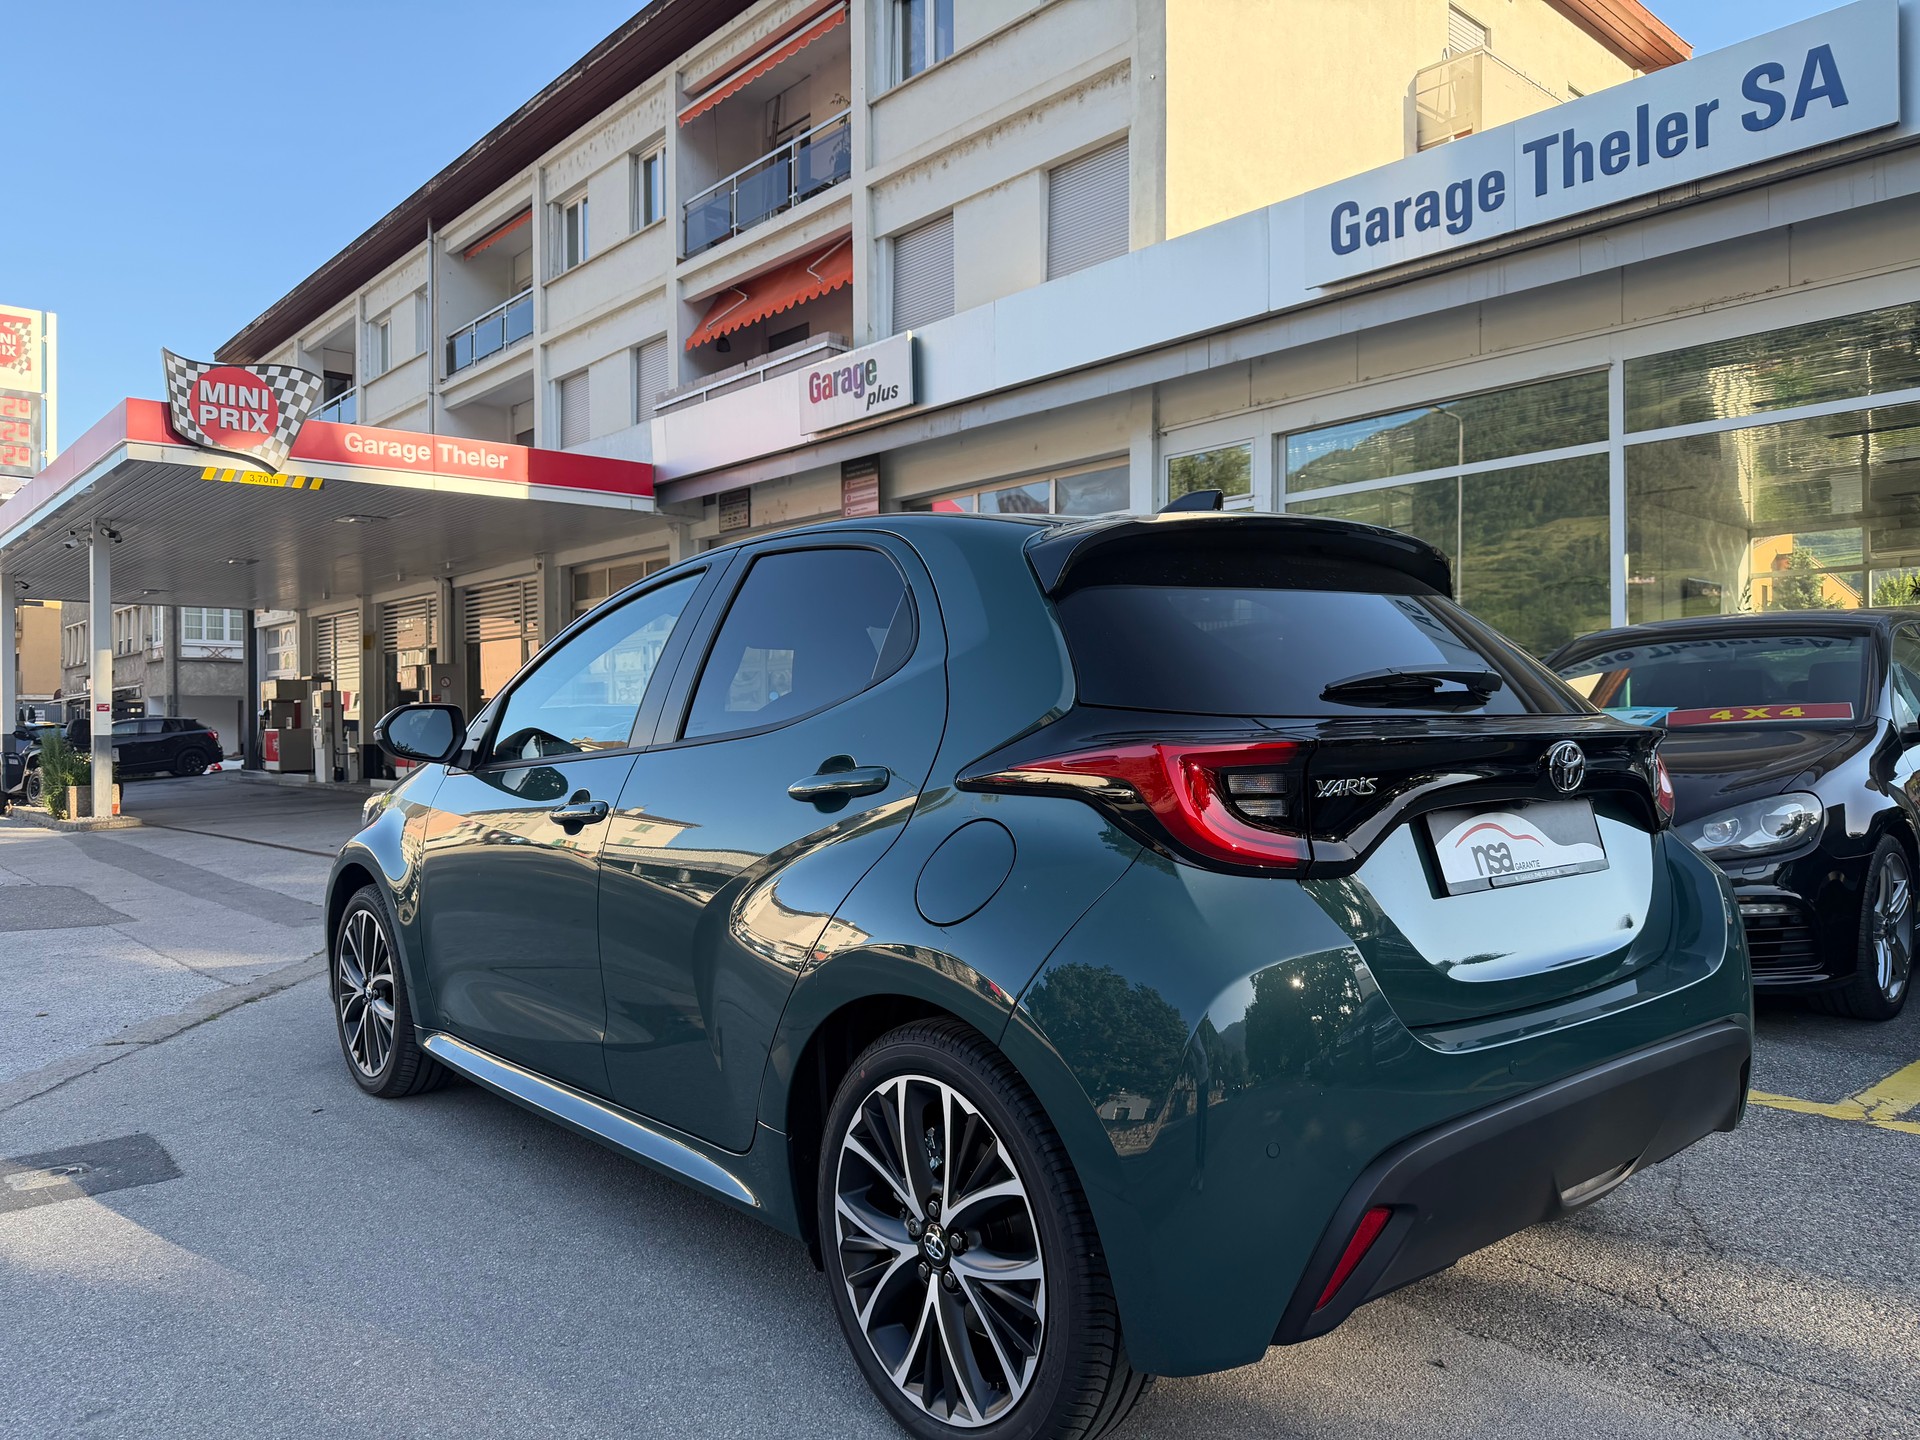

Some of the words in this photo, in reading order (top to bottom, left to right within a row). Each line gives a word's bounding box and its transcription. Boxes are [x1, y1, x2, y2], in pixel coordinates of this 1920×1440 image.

[1330, 170, 1505, 255] Garage
[1522, 98, 1719, 198] Theler
[1741, 43, 1849, 132] SA
[200, 380, 269, 411] MINI
[809, 358, 877, 404] Garage
[866, 384, 899, 411] plus
[200, 404, 269, 433] PRIX
[344, 432, 431, 464] Garage
[437, 443, 508, 469] Theler
[249, 474, 269, 484] 3.70
[1471, 842, 1515, 876] nsa
[1515, 859, 1541, 871] GARANTIE
